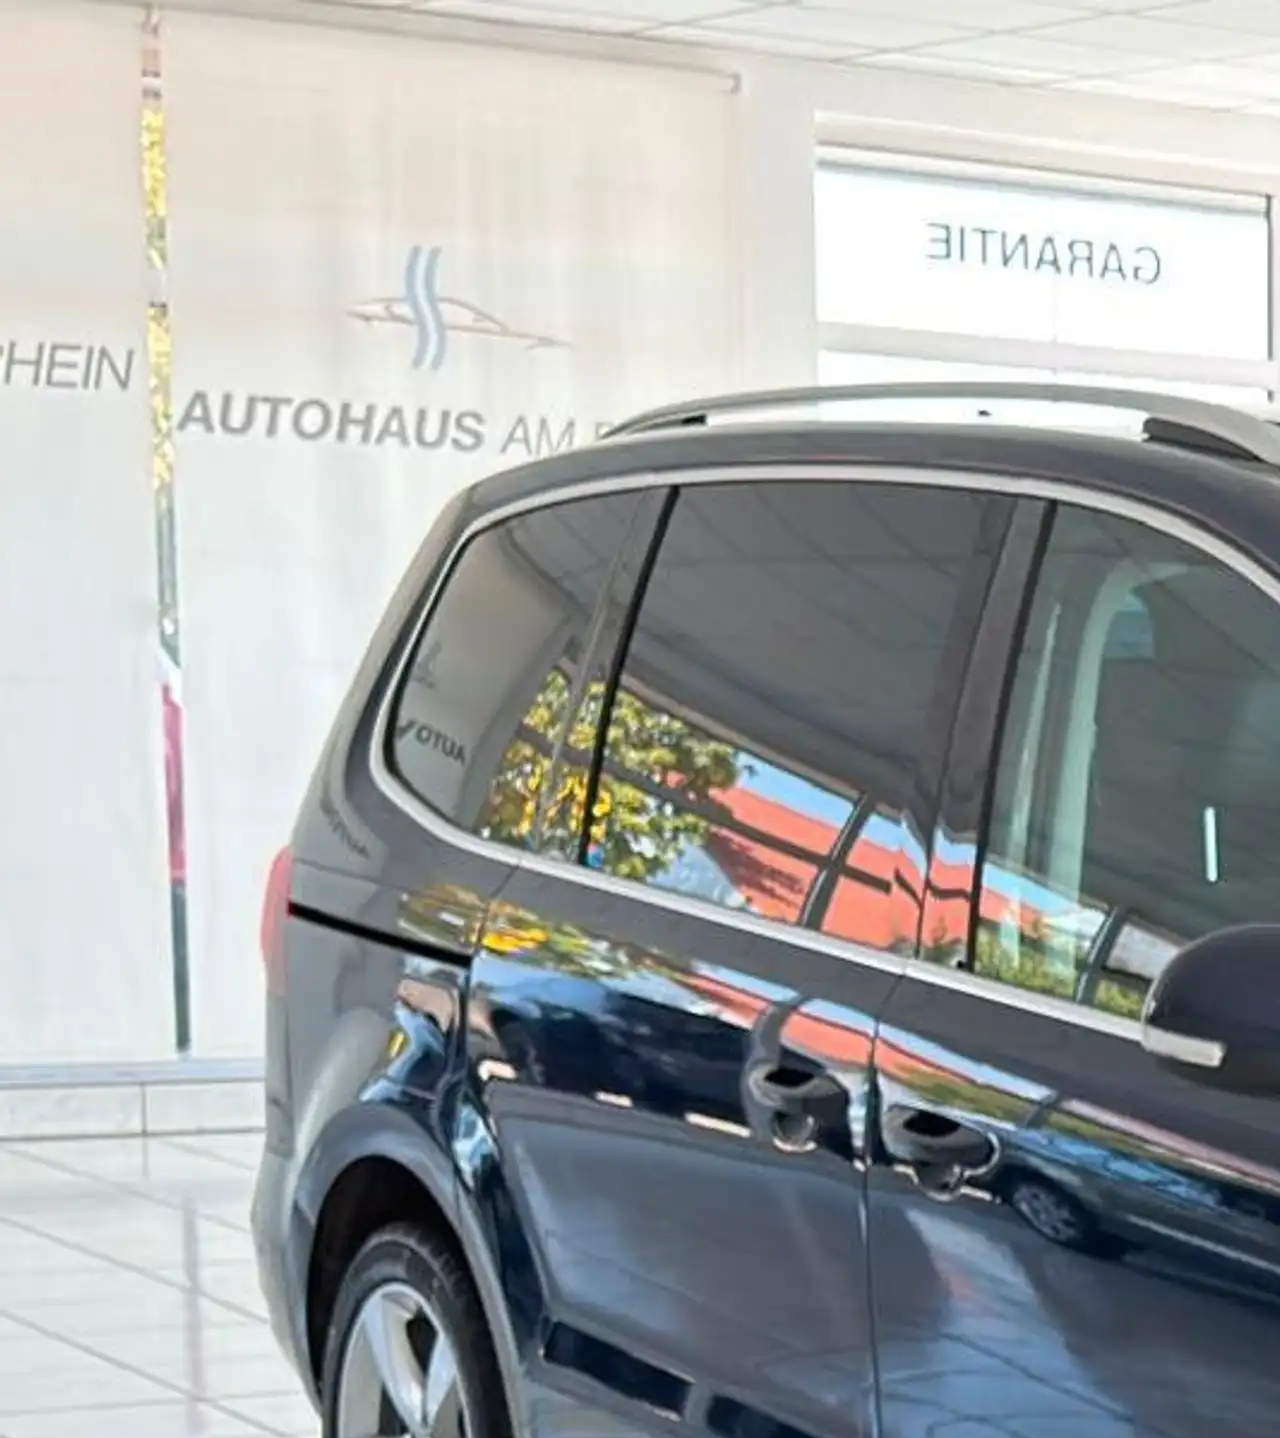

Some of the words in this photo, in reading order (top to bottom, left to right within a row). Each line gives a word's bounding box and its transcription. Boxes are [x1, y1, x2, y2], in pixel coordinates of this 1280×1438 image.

[0, 340, 134, 391] HEIN
[177, 391, 485, 453] AUTOHAUS
[501, 415, 575, 454] AM
